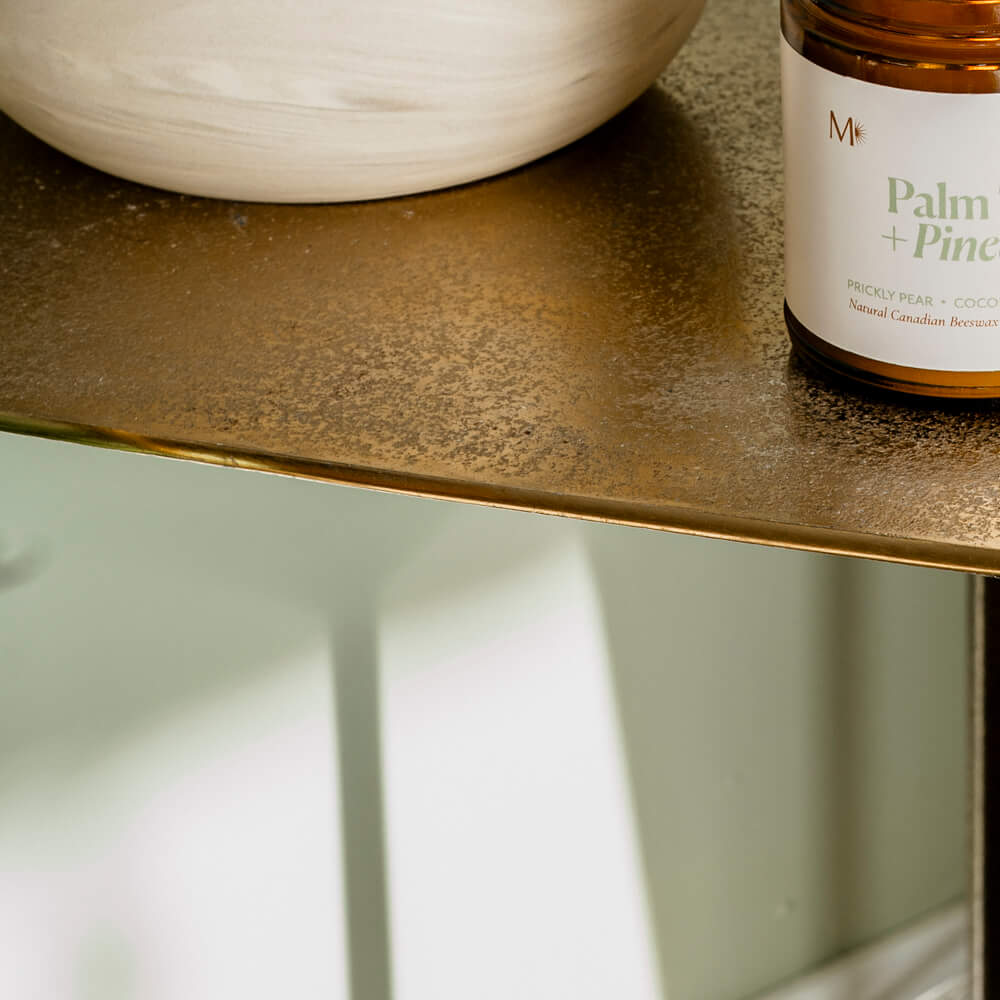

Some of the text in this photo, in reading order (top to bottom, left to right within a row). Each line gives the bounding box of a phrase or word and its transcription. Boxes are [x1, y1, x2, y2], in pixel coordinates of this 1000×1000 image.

[887, 176, 989, 220] Palm
[847, 279, 896, 301] PRICKLY
[899, 292, 934, 307] PEAR
[848, 297, 888, 319] Natural
[890, 309, 946, 327] Canadian
[950, 315, 999, 328] Beeswax
